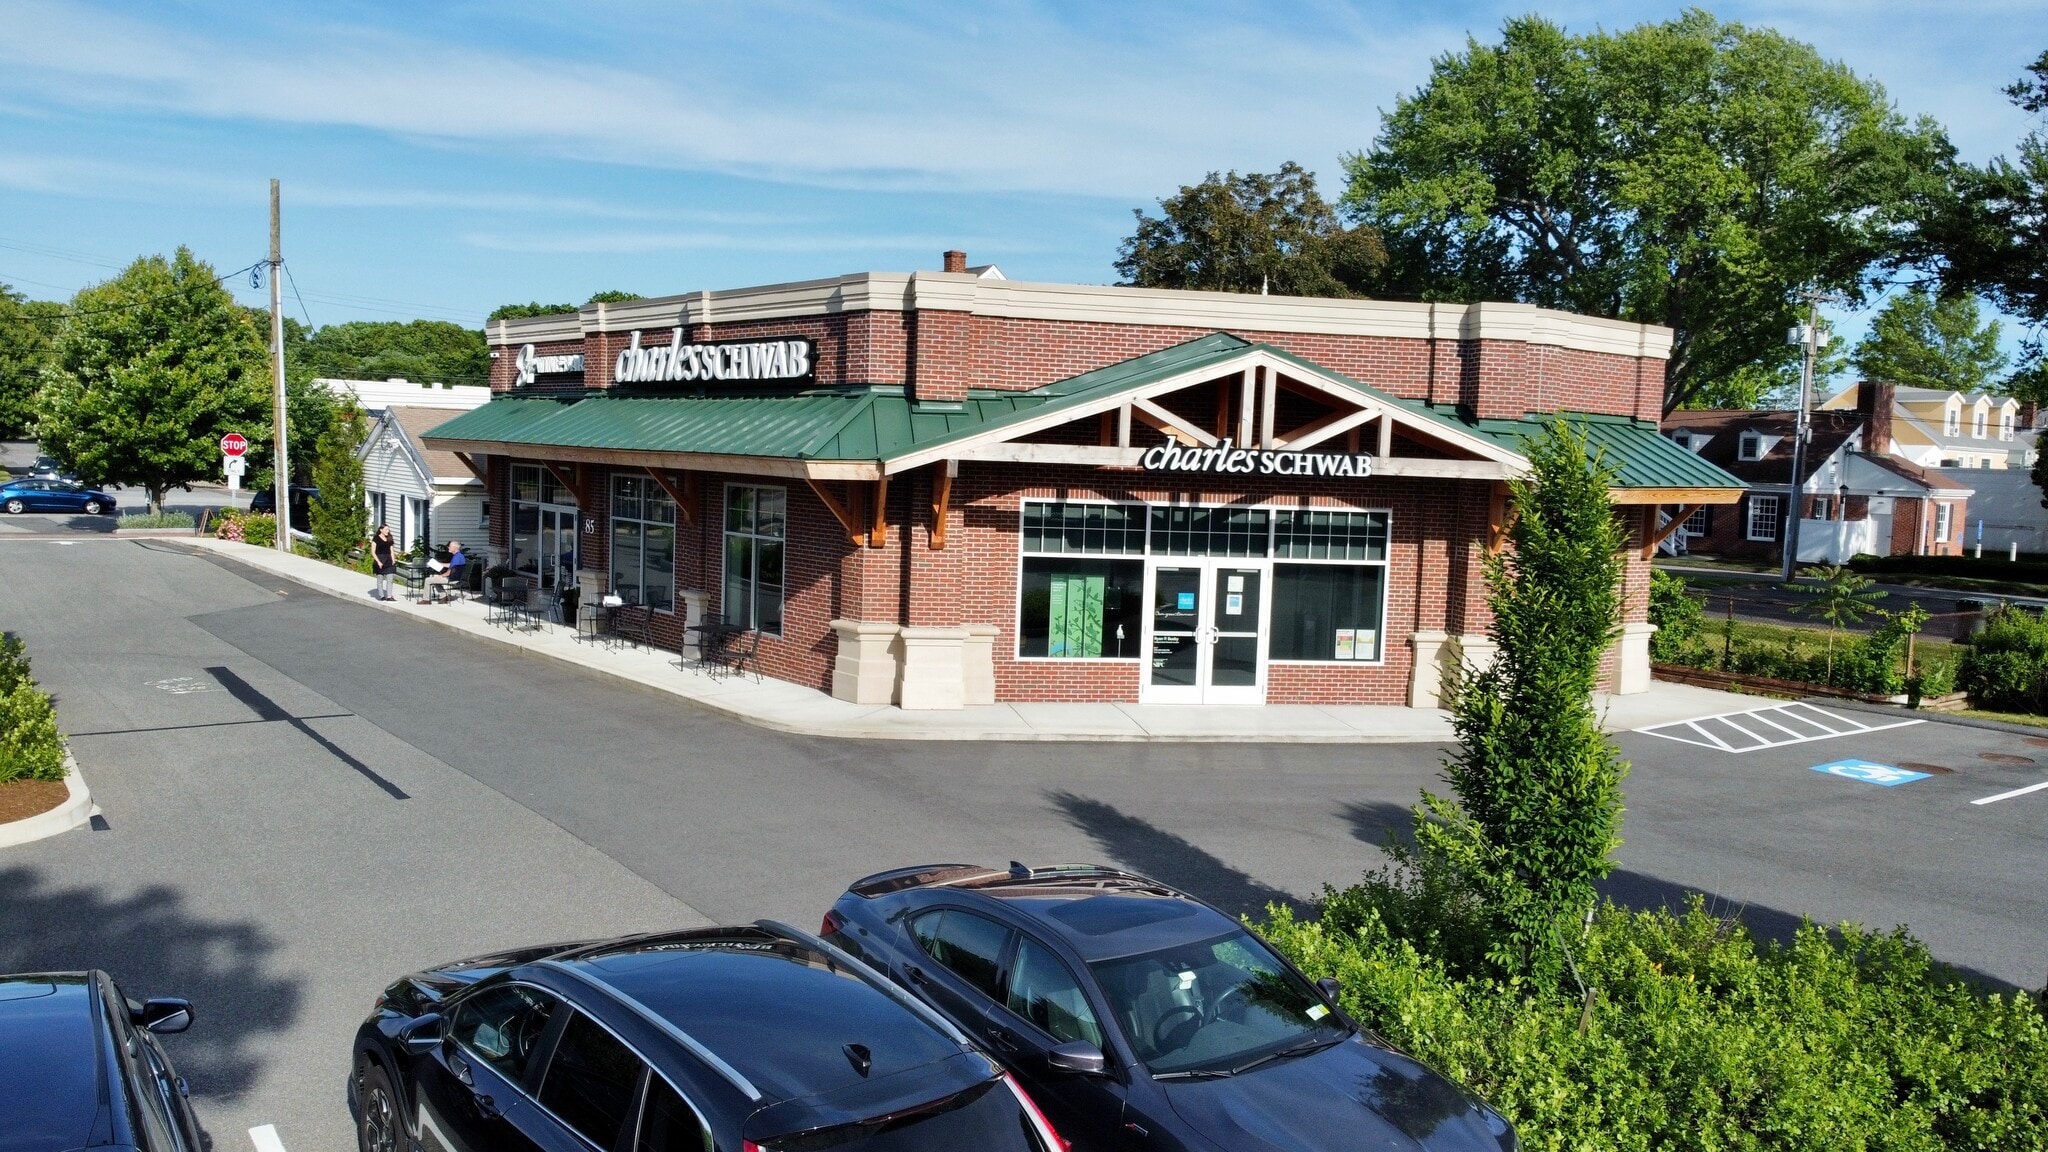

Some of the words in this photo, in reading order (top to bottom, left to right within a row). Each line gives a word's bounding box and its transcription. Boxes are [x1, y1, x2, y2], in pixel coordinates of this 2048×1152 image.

[615, 327, 700, 383] charles
[700, 341, 811, 381] SCHWAB
[223, 440, 246, 450] STOP
[1144, 435, 1259, 473] charles
[1259, 452, 1372, 477] SCHWAB
[585, 518, 595, 534] 85
